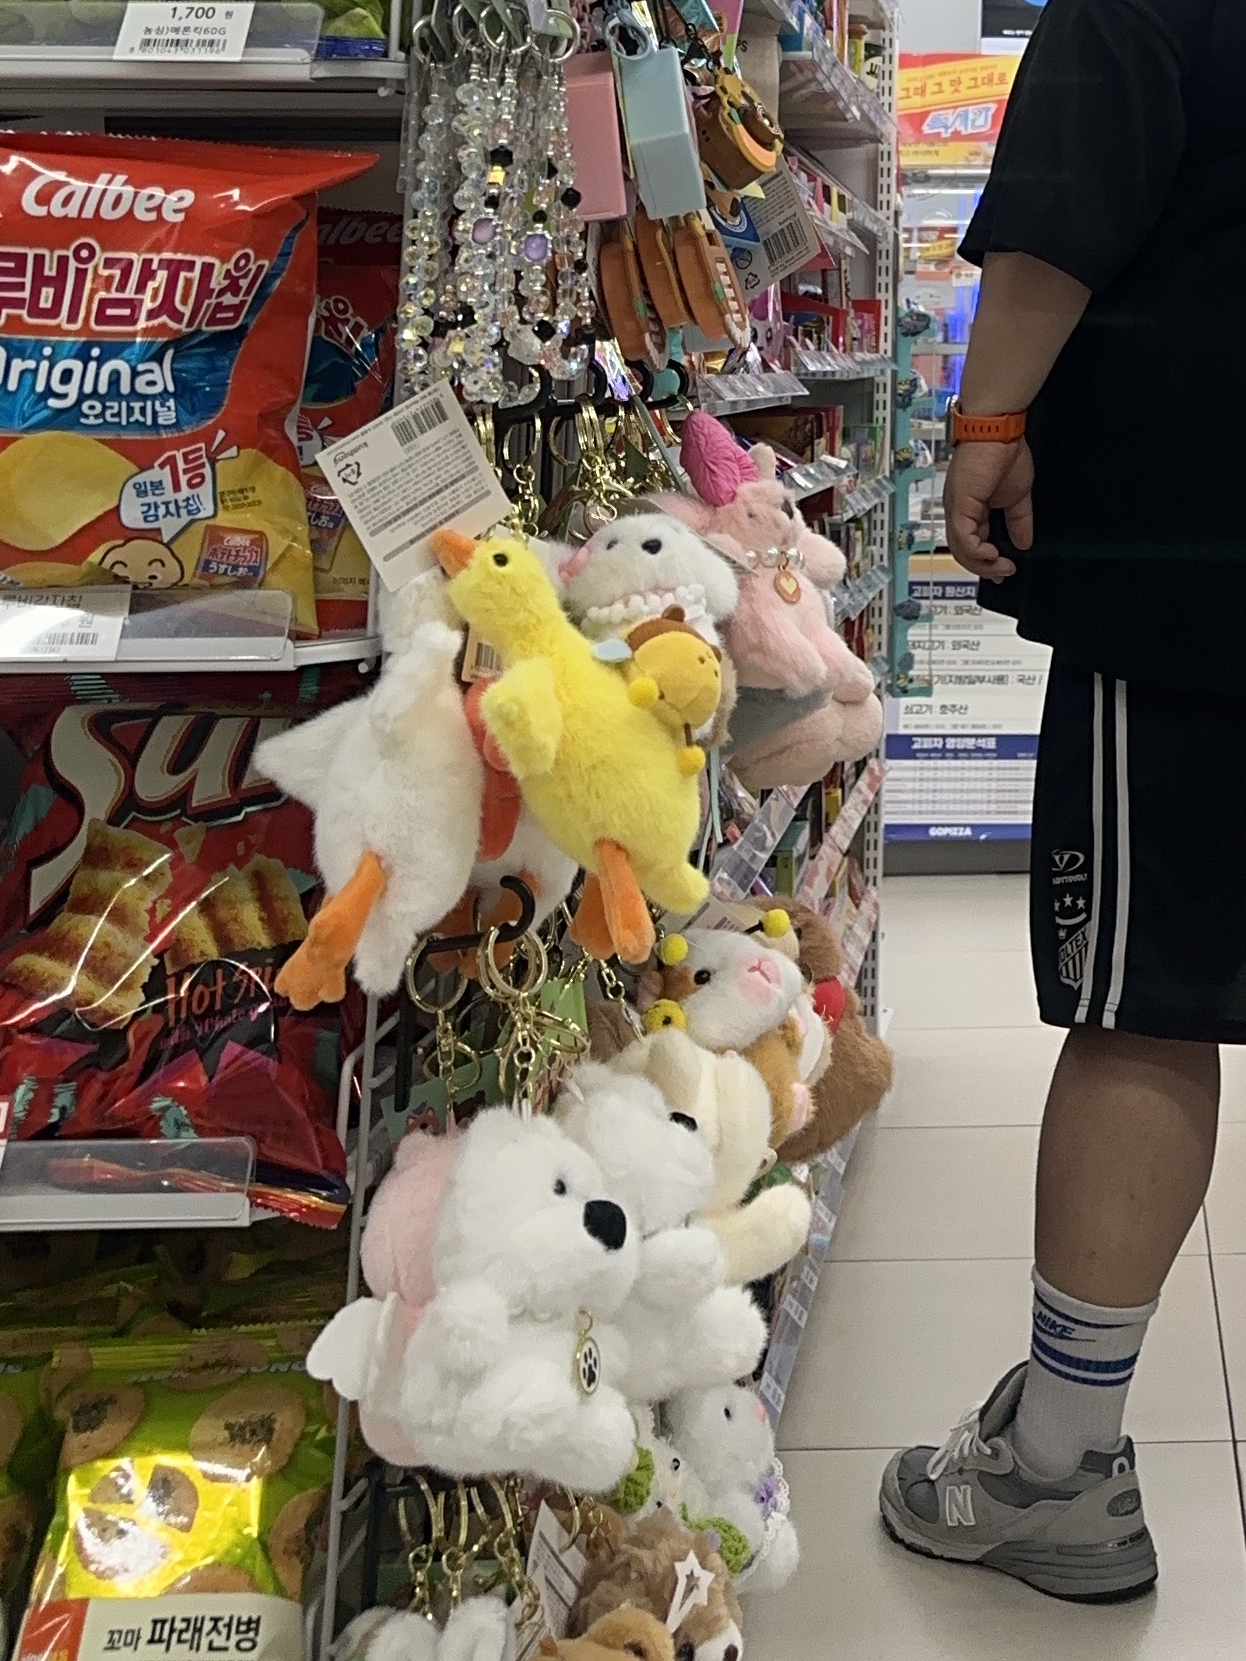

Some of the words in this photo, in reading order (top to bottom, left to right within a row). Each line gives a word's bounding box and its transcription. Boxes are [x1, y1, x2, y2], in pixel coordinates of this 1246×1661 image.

[170, 6, 216, 21] 1,700
[20, 169, 196, 224] Calbee
[0, 347, 176, 410] riginal
[79, 399, 178, 428] 오리지널
[132, 479, 166, 498] 일본
[156, 443, 208, 494] 1등
[166, 967, 226, 1028] Hot
[103, 1626, 142, 1652] 꼬마
[146, 1614, 262, 1653] 파래전병
